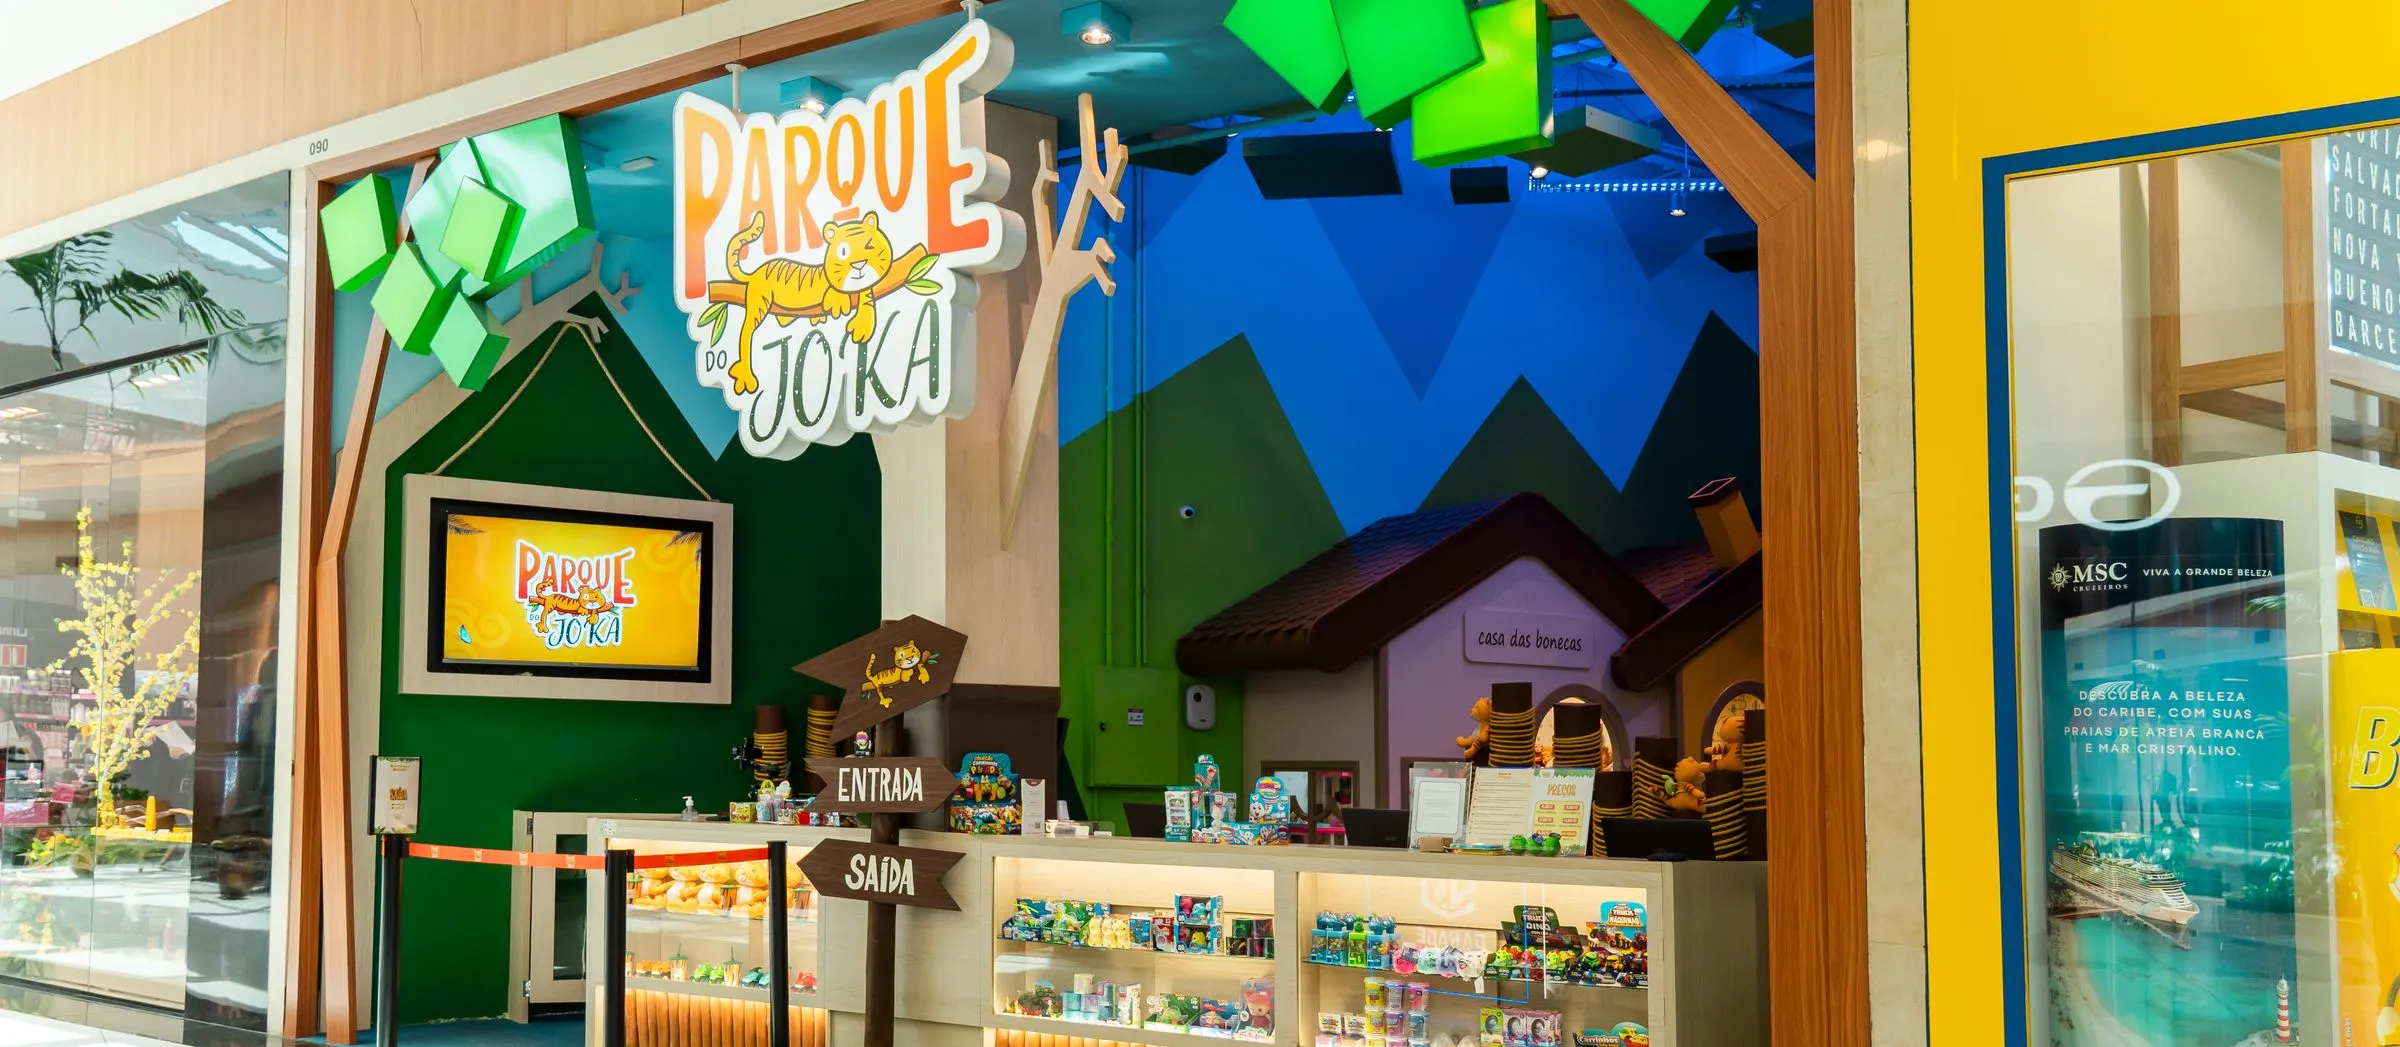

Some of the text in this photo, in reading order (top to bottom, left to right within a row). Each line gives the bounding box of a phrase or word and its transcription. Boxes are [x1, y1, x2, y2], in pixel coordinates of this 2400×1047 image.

[309, 138, 329, 156] 090
[683, 36, 989, 299] PARQUE
[2333, 226, 2380, 271] NOVA
[2334, 268, 2400, 314] BUENO
[2335, 309, 2398, 354] BARCE
[706, 350, 728, 373] DO
[518, 541, 635, 604] PARQUE
[2072, 562, 2128, 583] MSC
[2143, 567, 2273, 578] VIVA A GRANDE BELEZA
[2073, 583, 2129, 592] CRUZEIROS
[1478, 627, 1582, 652] casa das bonecas
[2079, 690, 2245, 702] DESCUBRA A BELEZA
[2073, 707, 2252, 719] DO CARIBE, COM SUAS
[2064, 726, 2265, 740] PRAIAS DE AREIA BRANCA
[2085, 743, 2241, 757] E MAR CRISTALINO.
[2349, 705, 2400, 790] B
[838, 766, 923, 802] ENTRADA
[1546, 783, 1578, 798] PREÇOS
[845, 853, 915, 896] SAÍDA
